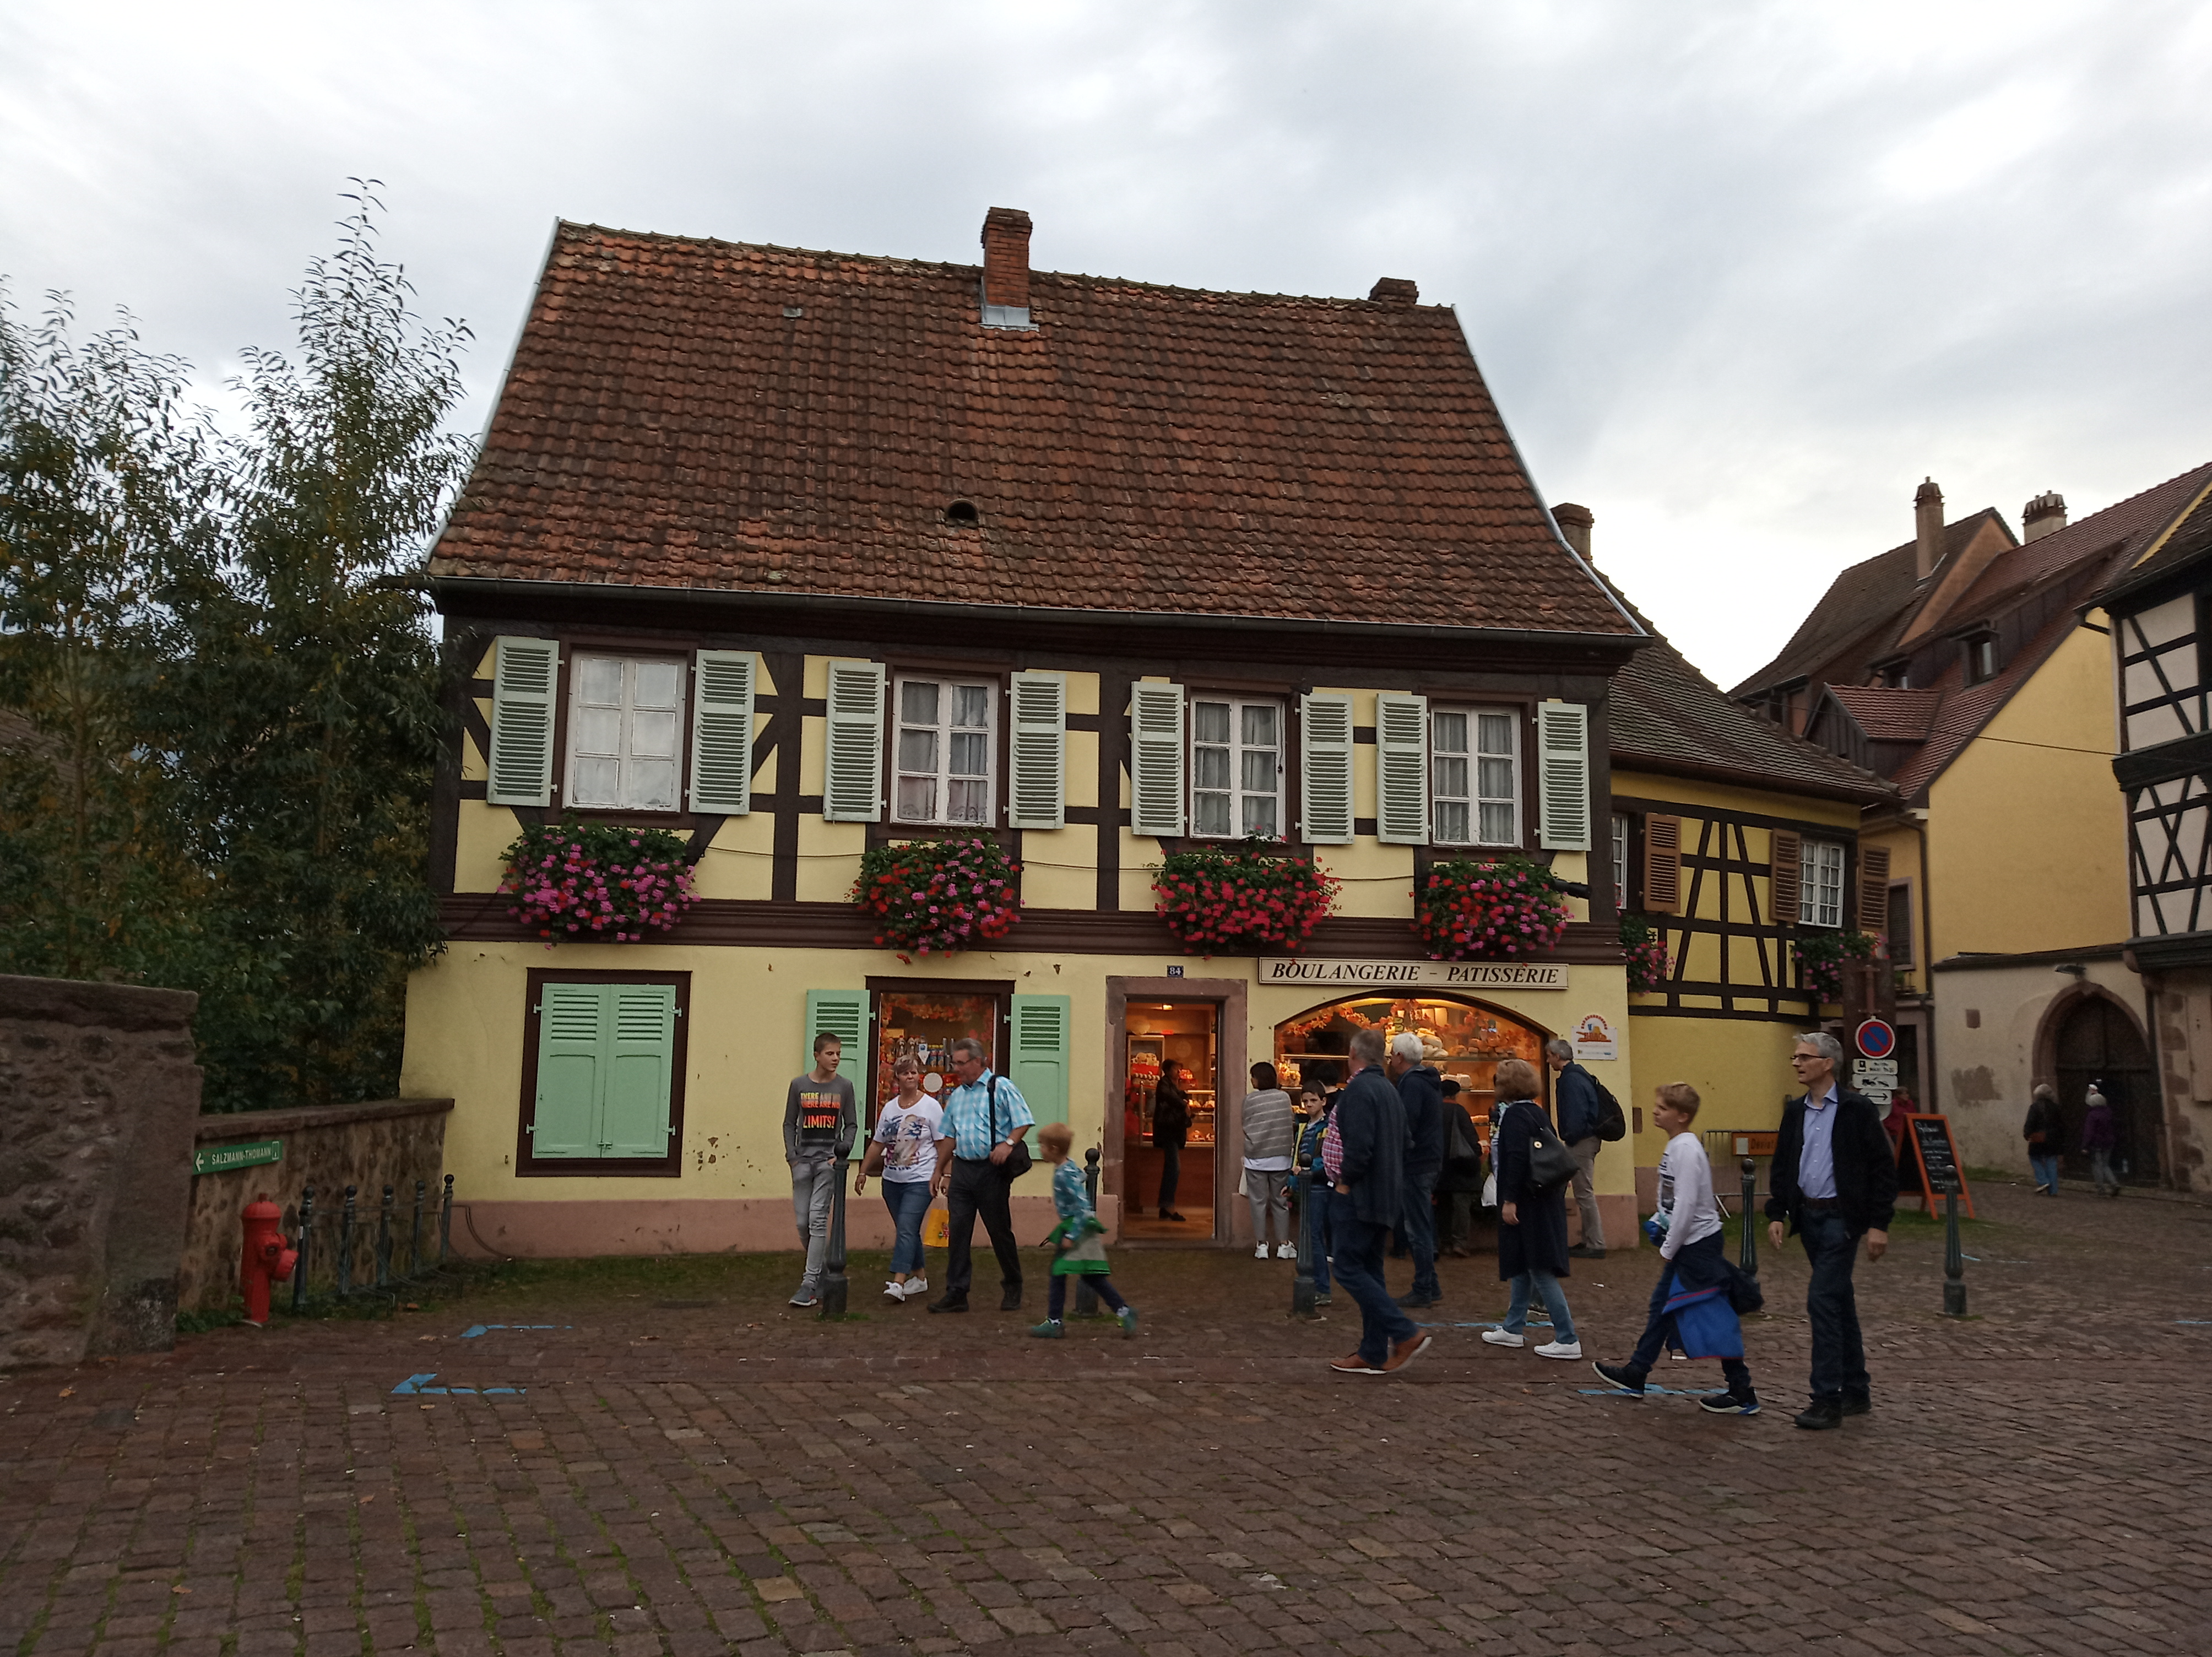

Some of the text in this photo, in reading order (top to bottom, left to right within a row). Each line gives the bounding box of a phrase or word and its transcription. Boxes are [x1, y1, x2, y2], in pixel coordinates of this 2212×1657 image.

[1169, 967, 1181, 975] 84
[1271, 963, 1421, 981] BOULANGERIE
[1446, 966, 1559, 983] PATISSERIE
[803, 1115, 836, 1129] LIMITS!
[212, 1146, 272, 1165] SALZMANN-THOMANN
